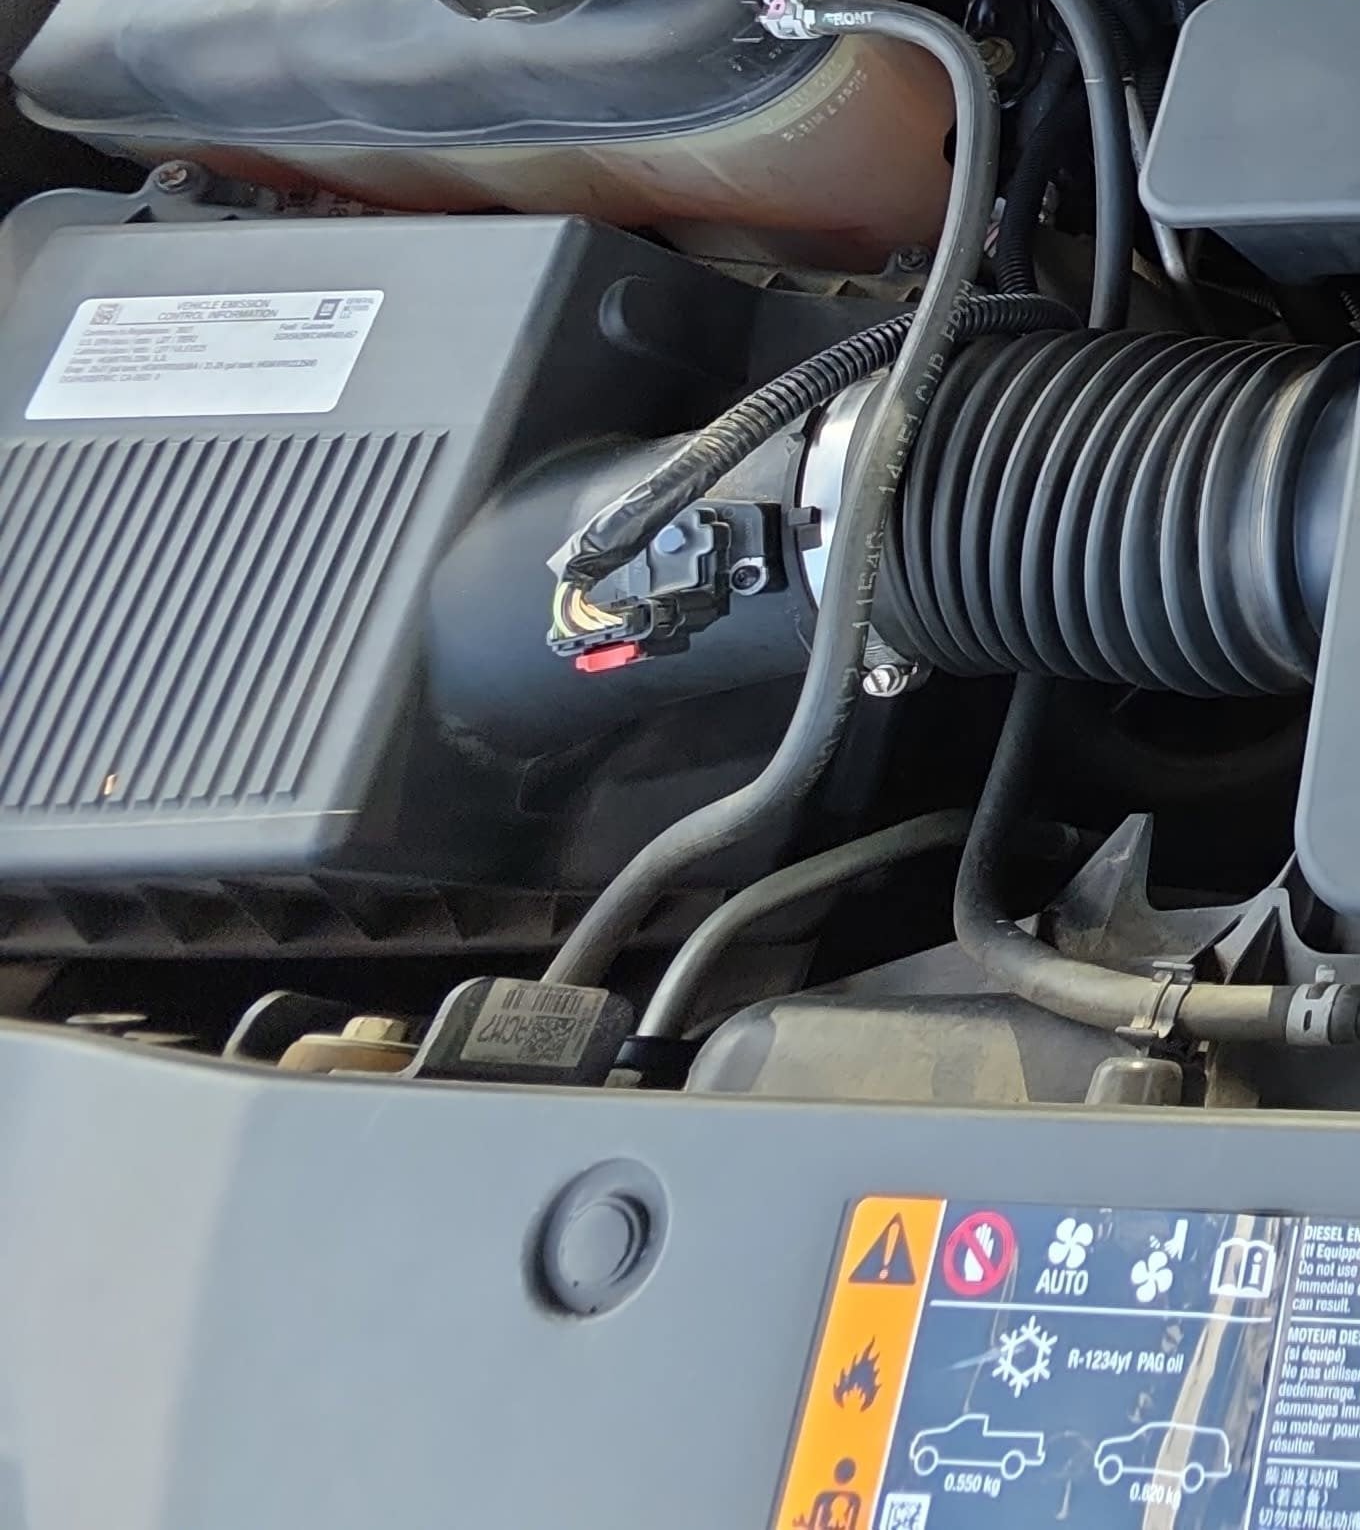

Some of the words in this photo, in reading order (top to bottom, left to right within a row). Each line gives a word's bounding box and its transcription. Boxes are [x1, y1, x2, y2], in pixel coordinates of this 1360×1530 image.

[177, 301, 220, 311] VEHICLE
[221, 298, 272, 309] EMISSION
[157, 310, 205, 321] CONTROL
[207, 308, 279, 320] INFORMATION
[1304, 1225, 1345, 1242] DIESEL
[1300, 1243, 1315, 1260] (If
[1298, 1260, 1314, 1276] Do
[1316, 1261, 1336, 1277] not
[1337, 1266, 1358, 1278] use
[1034, 1268, 1089, 1296] AUTO
[1294, 1277, 1356, 1296] Immediate
[1292, 1300, 1313, 1312] can
[1315, 1298, 1351, 1314] result.
[1288, 1327, 1337, 1345] MOTEUR
[1067, 1348, 1133, 1375] R-1234yf
[1136, 1351, 1165, 1373] PAG
[1166, 1353, 1185, 1374] oil
[1284, 1345, 1300, 1363] (si
[1301, 1346, 1347, 1366] équipé)
[1281, 1363, 1298, 1379] Ne
[1299, 1366, 1321, 1382] pas
[1275, 1400, 1339, 1420] dommages
[1272, 1419, 1287, 1435] au
[1289, 1422, 1331, 1436] moteur
[1268, 1437, 1316, 1454] résulter.
[943, 1473, 982, 1494] 0.550
[983, 1475, 1001, 1498] kg
[1165, 1485, 1182, 1510] kg
